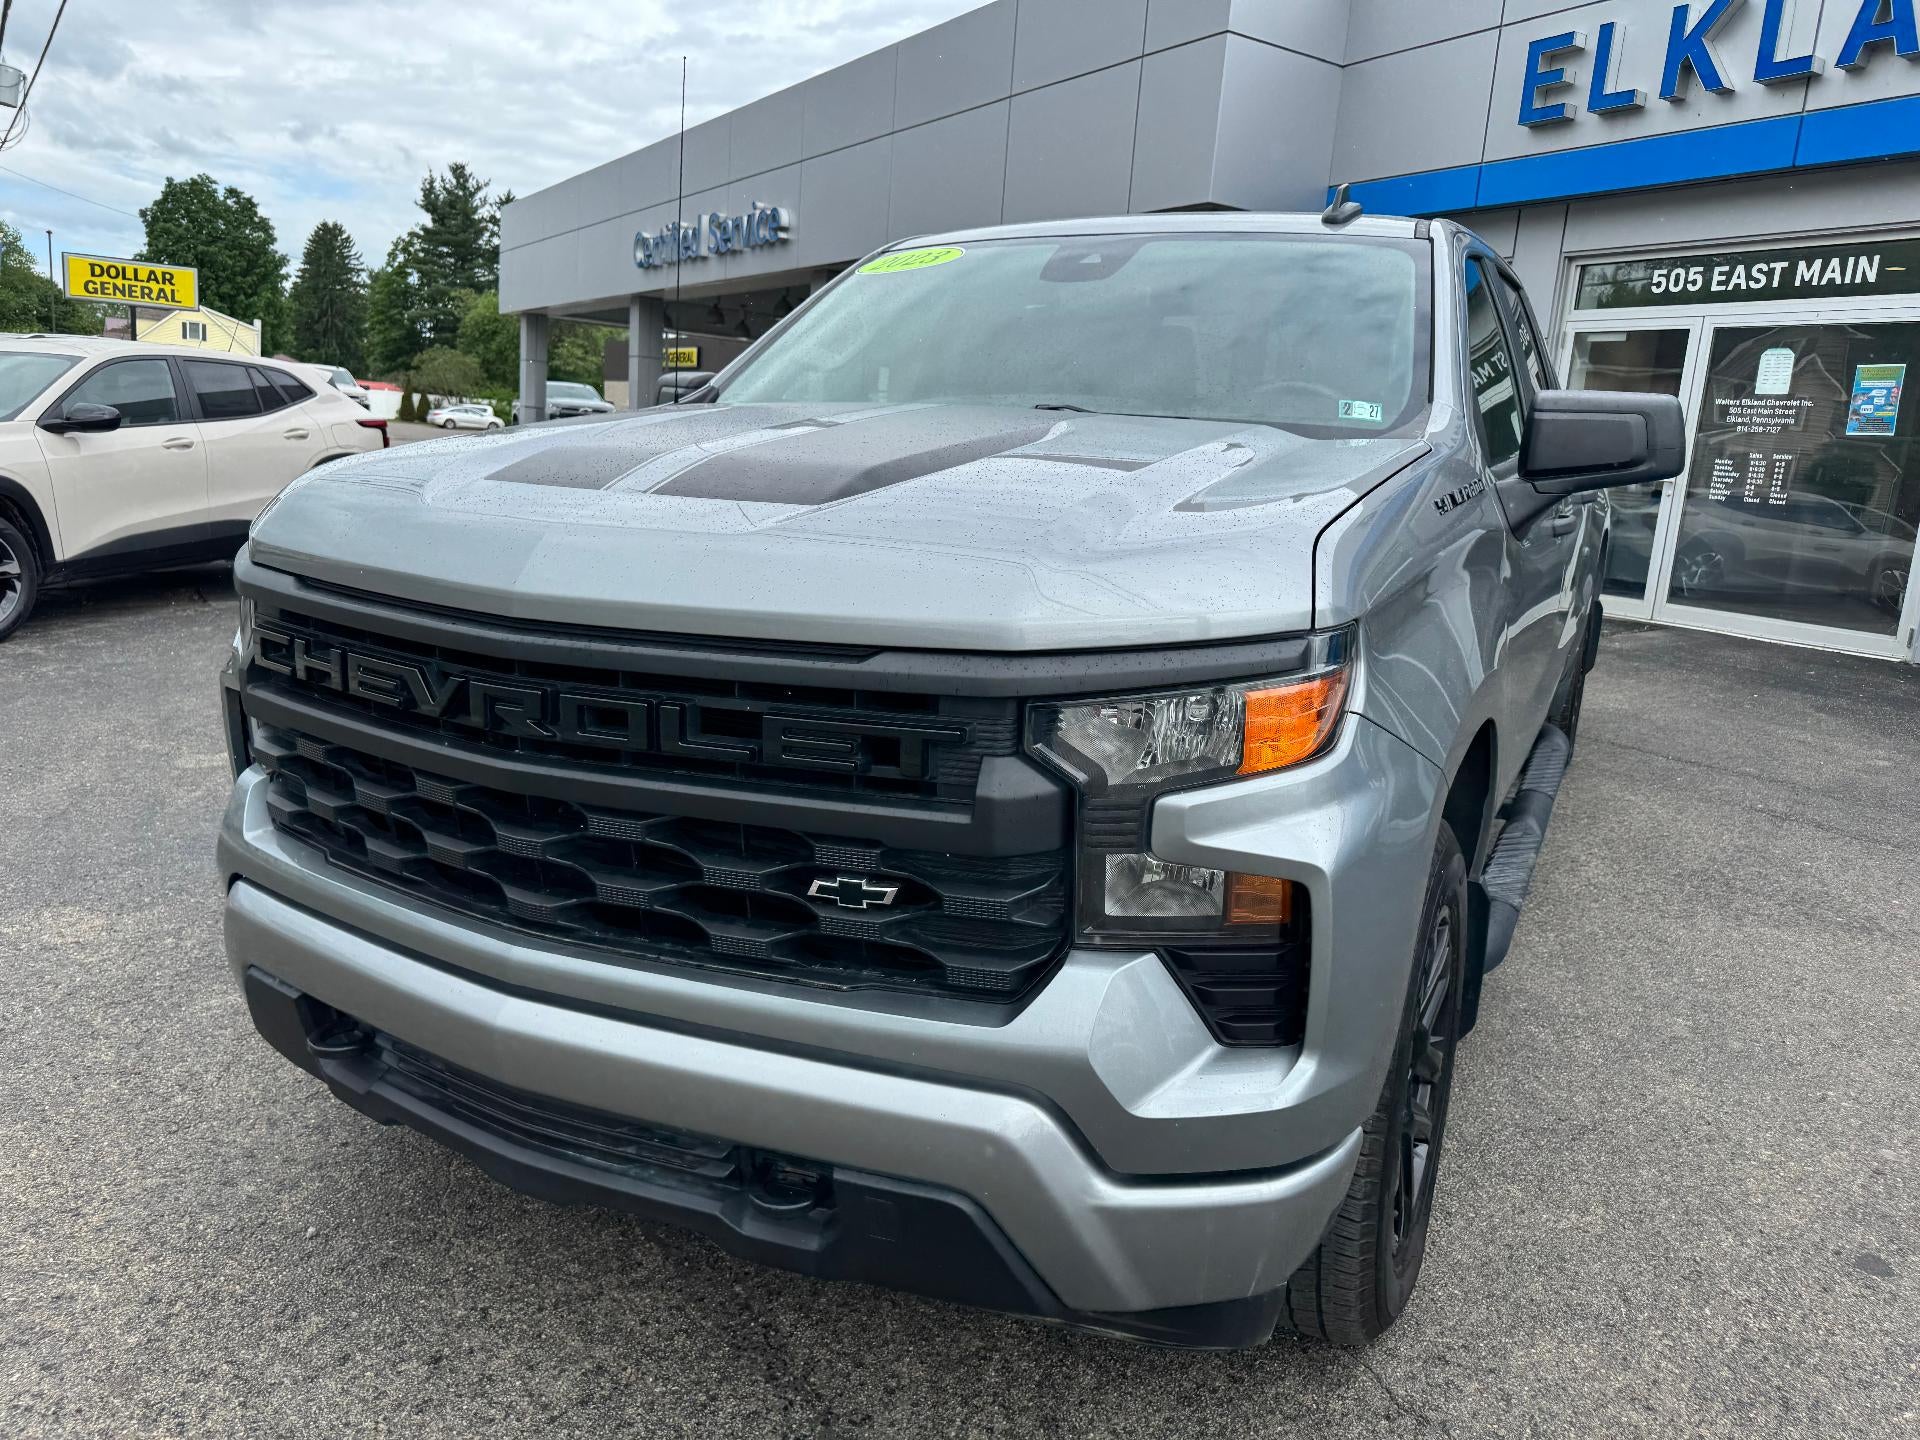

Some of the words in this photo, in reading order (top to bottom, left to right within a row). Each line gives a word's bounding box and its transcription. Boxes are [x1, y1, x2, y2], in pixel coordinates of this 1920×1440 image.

[633, 214, 709, 269] Certified
[708, 200, 790, 254] Service
[88, 262, 176, 286] DOLLAR
[1650, 266, 1704, 294] 505
[1710, 261, 1789, 292] EAST
[1794, 254, 1882, 287] MAIN
[83, 279, 183, 304] GENERAL
[1343, 402, 1352, 416] 2
[1369, 404, 1379, 418] 27
[1715, 398, 1740, 407] Walters
[1741, 398, 1766, 406] Elkland
[1766, 399, 1800, 407] Chevrolet
[1801, 399, 1814, 407] Inc.
[1752, 416, 1795, 425] Pennsylvania
[251, 629, 977, 781] CHEVROLET
